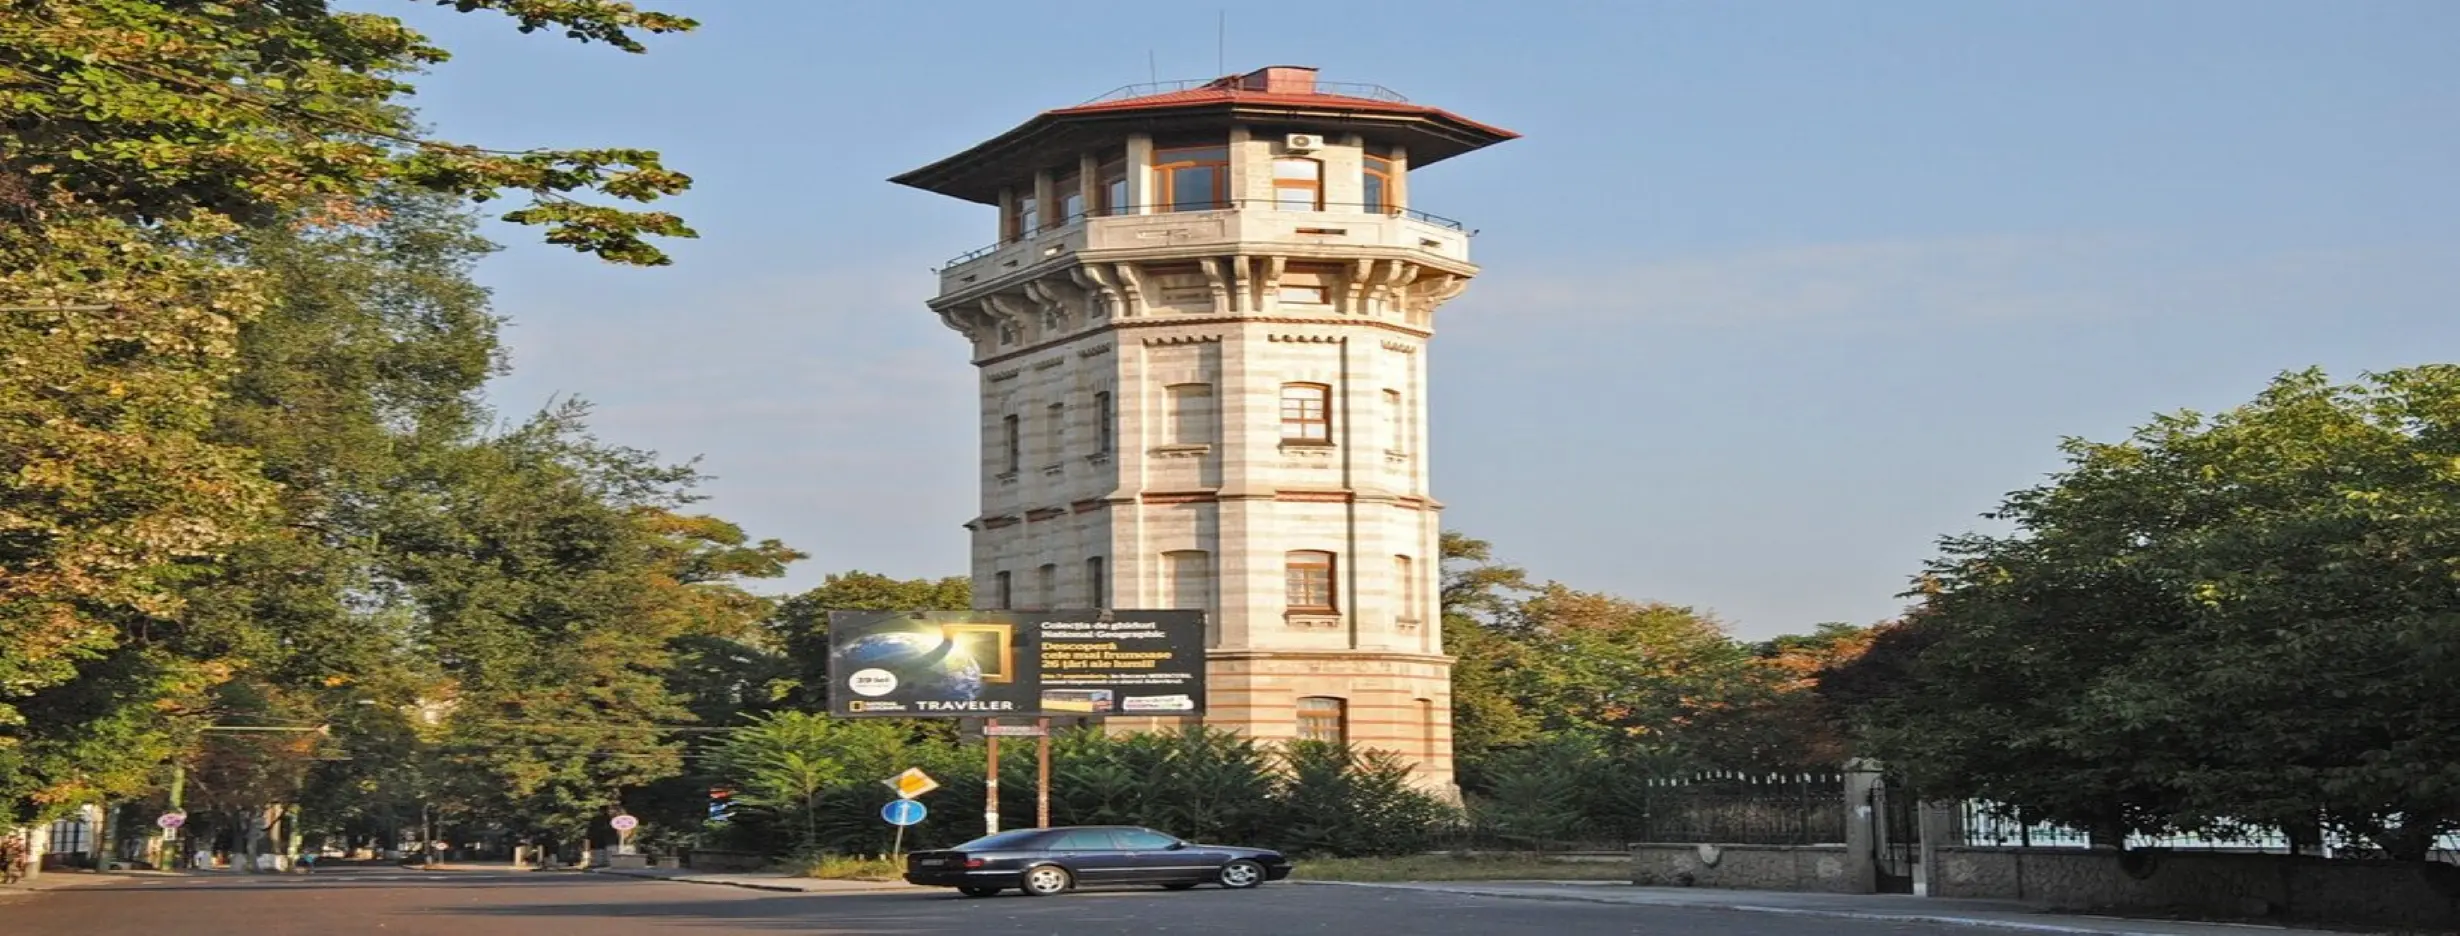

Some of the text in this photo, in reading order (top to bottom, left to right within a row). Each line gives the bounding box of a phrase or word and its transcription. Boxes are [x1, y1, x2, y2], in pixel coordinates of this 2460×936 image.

[1094, 622, 1109, 630] de
[1096, 631, 1166, 639] Geographic
[1089, 660, 1112, 668] ale
[916, 700, 1014, 710] TRAVELER
